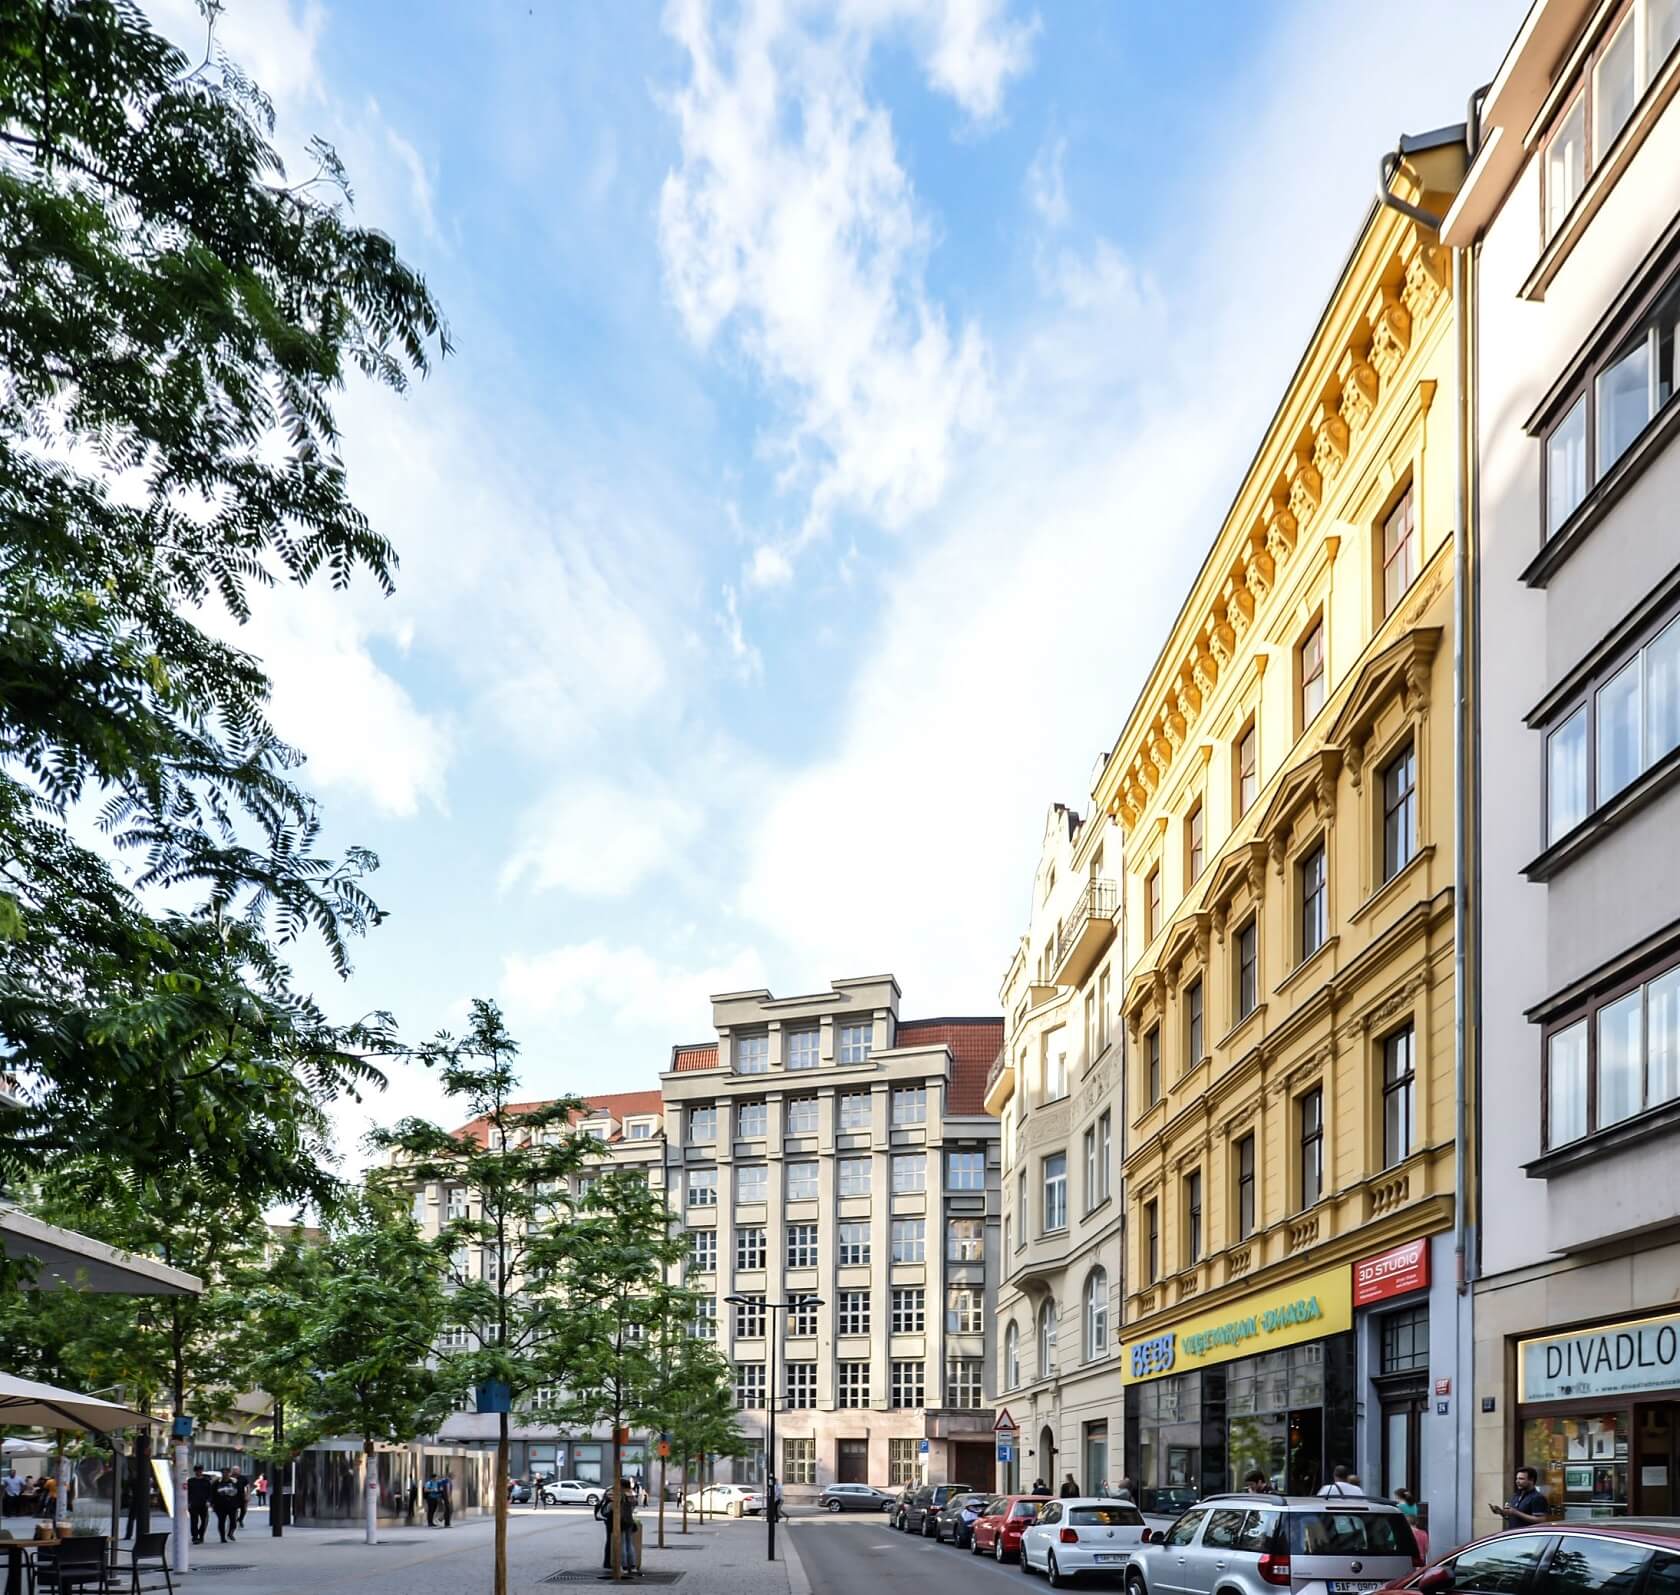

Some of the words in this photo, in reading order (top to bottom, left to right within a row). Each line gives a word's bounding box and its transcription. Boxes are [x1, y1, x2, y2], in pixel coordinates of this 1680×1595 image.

[1359, 1267, 1374, 1282] 3D
[1375, 1252, 1418, 1276] STUDIO
[1262, 1295, 1323, 1334] DHABA
[1546, 1325, 1677, 1380] DIVADLO
